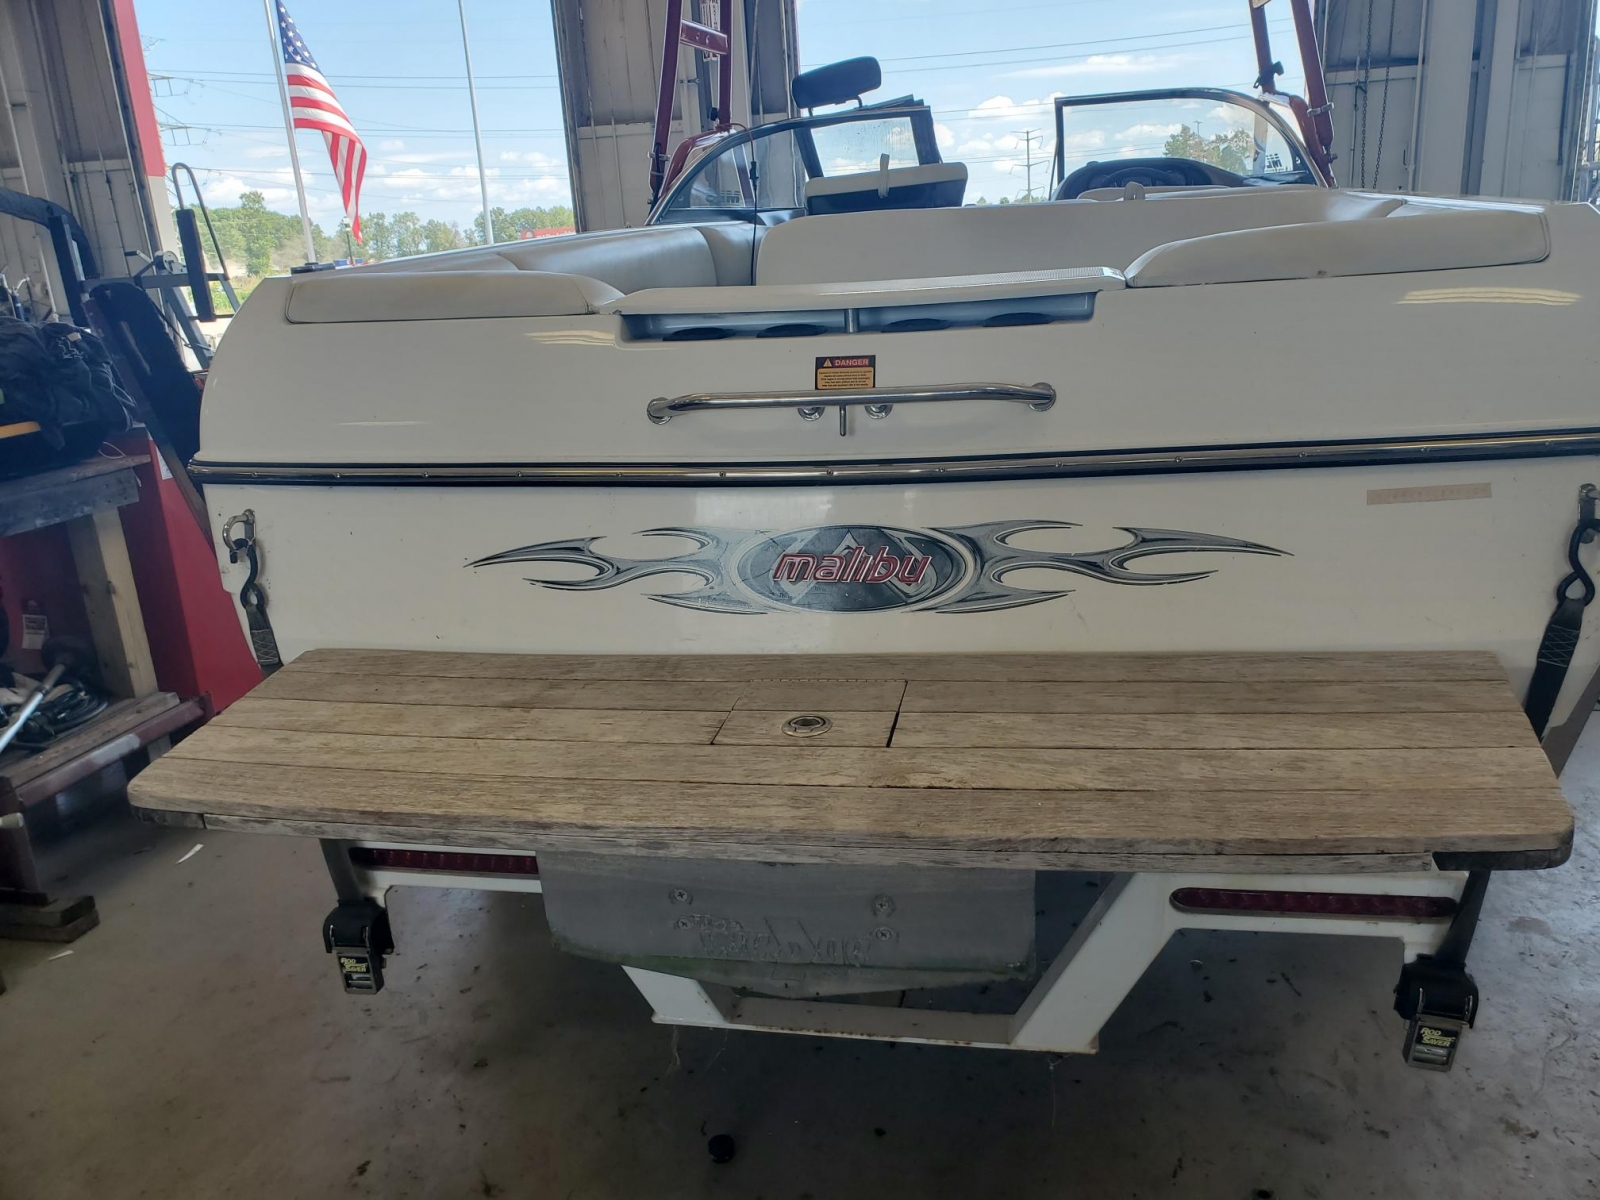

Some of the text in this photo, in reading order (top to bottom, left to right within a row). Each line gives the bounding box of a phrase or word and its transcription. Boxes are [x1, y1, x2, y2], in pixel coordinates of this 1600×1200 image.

[834, 358, 869, 366] DANGER
[773, 545, 933, 584] malibu
[1420, 1027, 1442, 1036] ROD
[1421, 1036, 1451, 1047] SAVER
